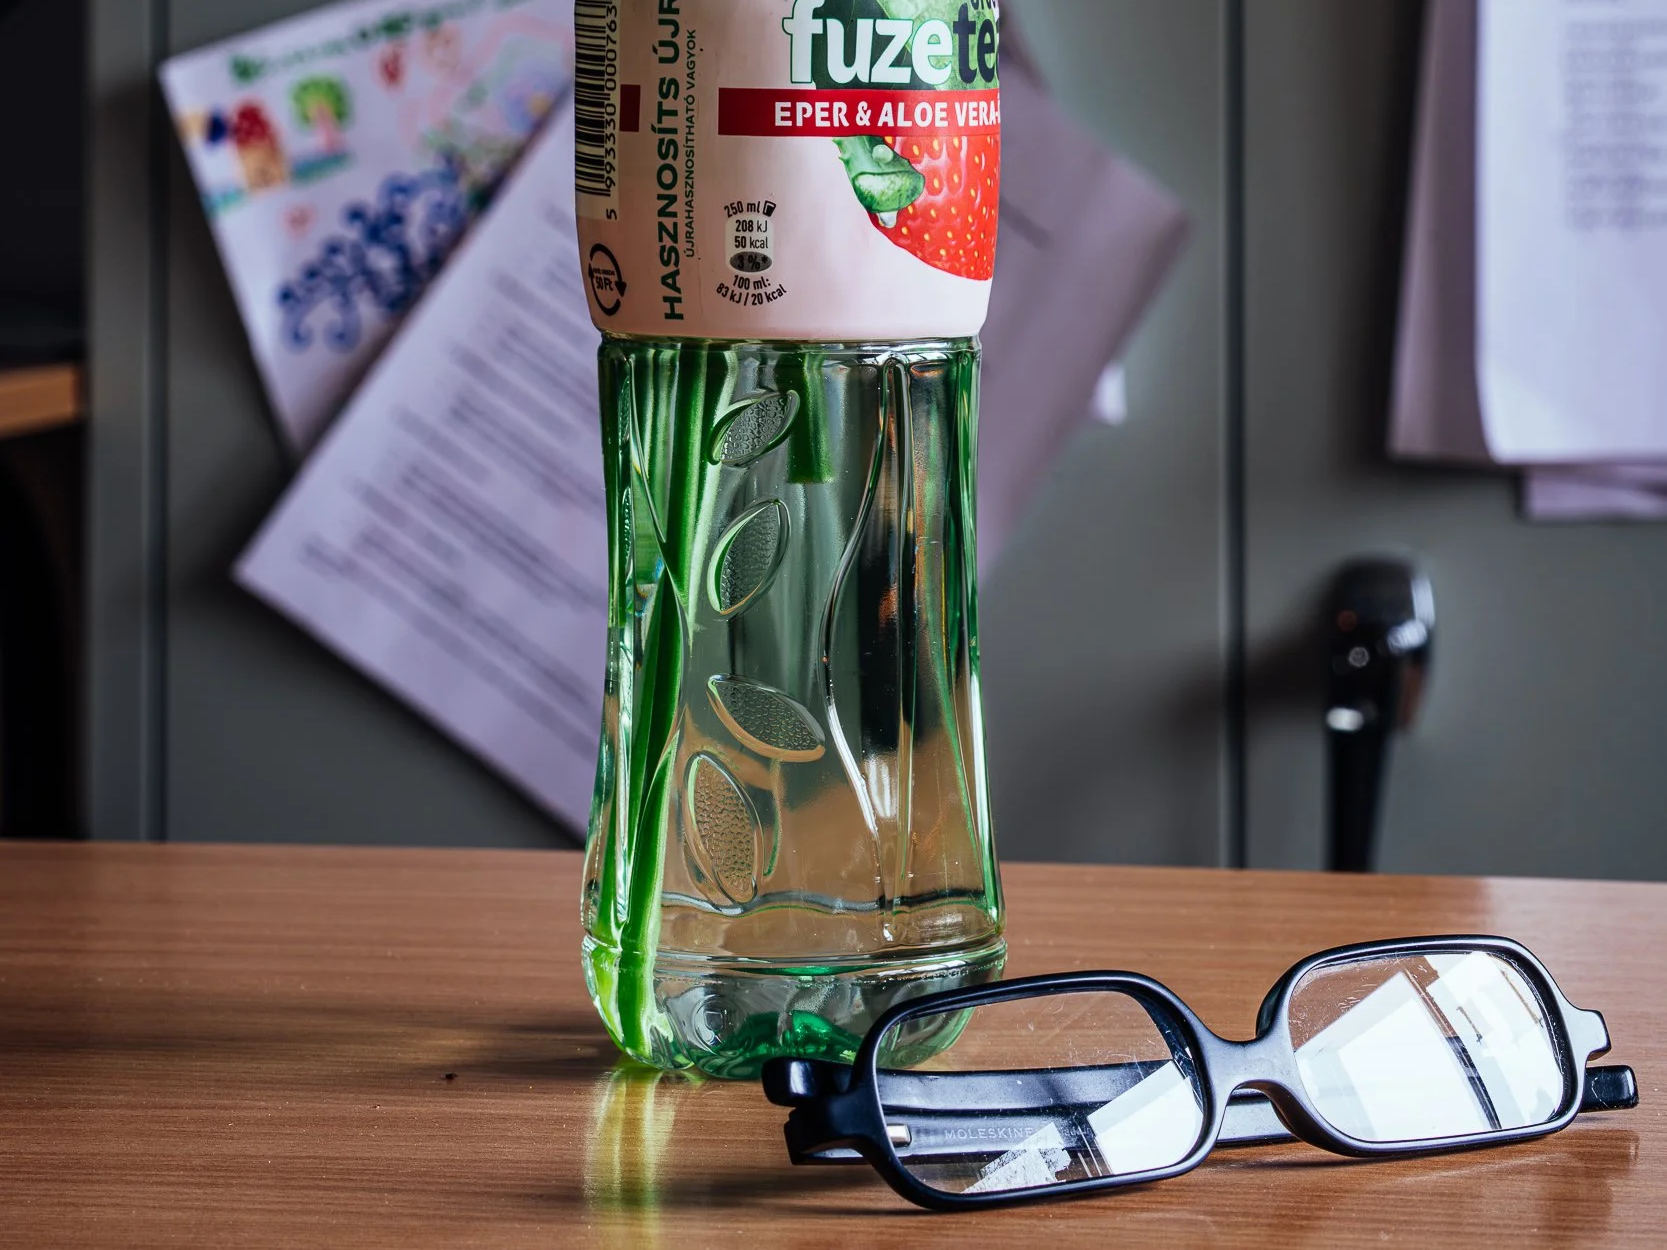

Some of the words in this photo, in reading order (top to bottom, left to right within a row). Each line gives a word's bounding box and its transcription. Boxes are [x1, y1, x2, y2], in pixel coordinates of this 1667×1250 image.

[604, 5, 618, 92] 000763
[686, 29, 696, 90] VAGYOK
[774, 101, 850, 128] EPER
[855, 101, 872, 127] &
[877, 101, 949, 128] ALOE
[604, 103, 618, 189] 993330
[683, 94, 695, 258] ÚJRAHASZNOSÍTHATÓ
[651, 76, 684, 321] HASZNOSÍTS
[724, 201, 744, 218] 250
[747, 201, 761, 214] ml
[606, 208, 618, 221] 5
[735, 219, 754, 233] 208
[757, 220, 768, 233] kJ
[734, 235, 747, 249] 50
[749, 236, 769, 249] kcal
[737, 254, 745, 270] 3
[716, 282, 730, 298] 83
[729, 289, 743, 304] kJ
[751, 292, 764, 306] 20
[764, 284, 787, 303] kcal
[733, 274, 750, 291] 100
[753, 276, 771, 291] ml:
